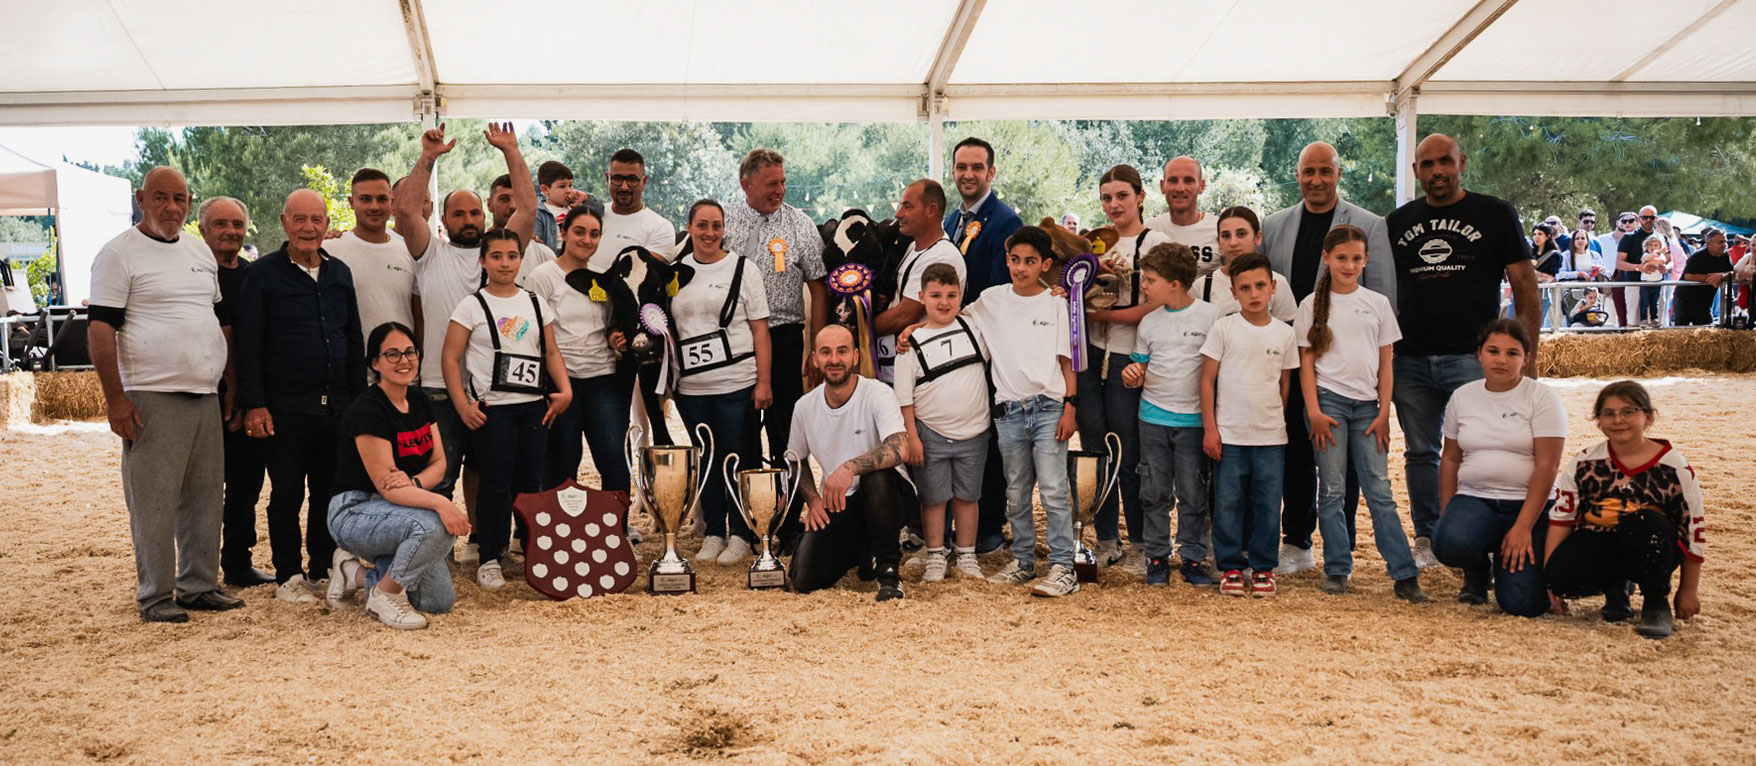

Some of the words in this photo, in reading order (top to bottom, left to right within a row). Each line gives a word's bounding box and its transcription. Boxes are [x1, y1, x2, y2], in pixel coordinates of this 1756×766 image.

[1397, 222, 1425, 247] TOM
[1429, 218, 1482, 242] TAILOR
[1435, 264, 1467, 272] QUALITY
[689, 343, 713, 365] 55
[940, 339, 952, 356] 7
[512, 361, 537, 384] 45
